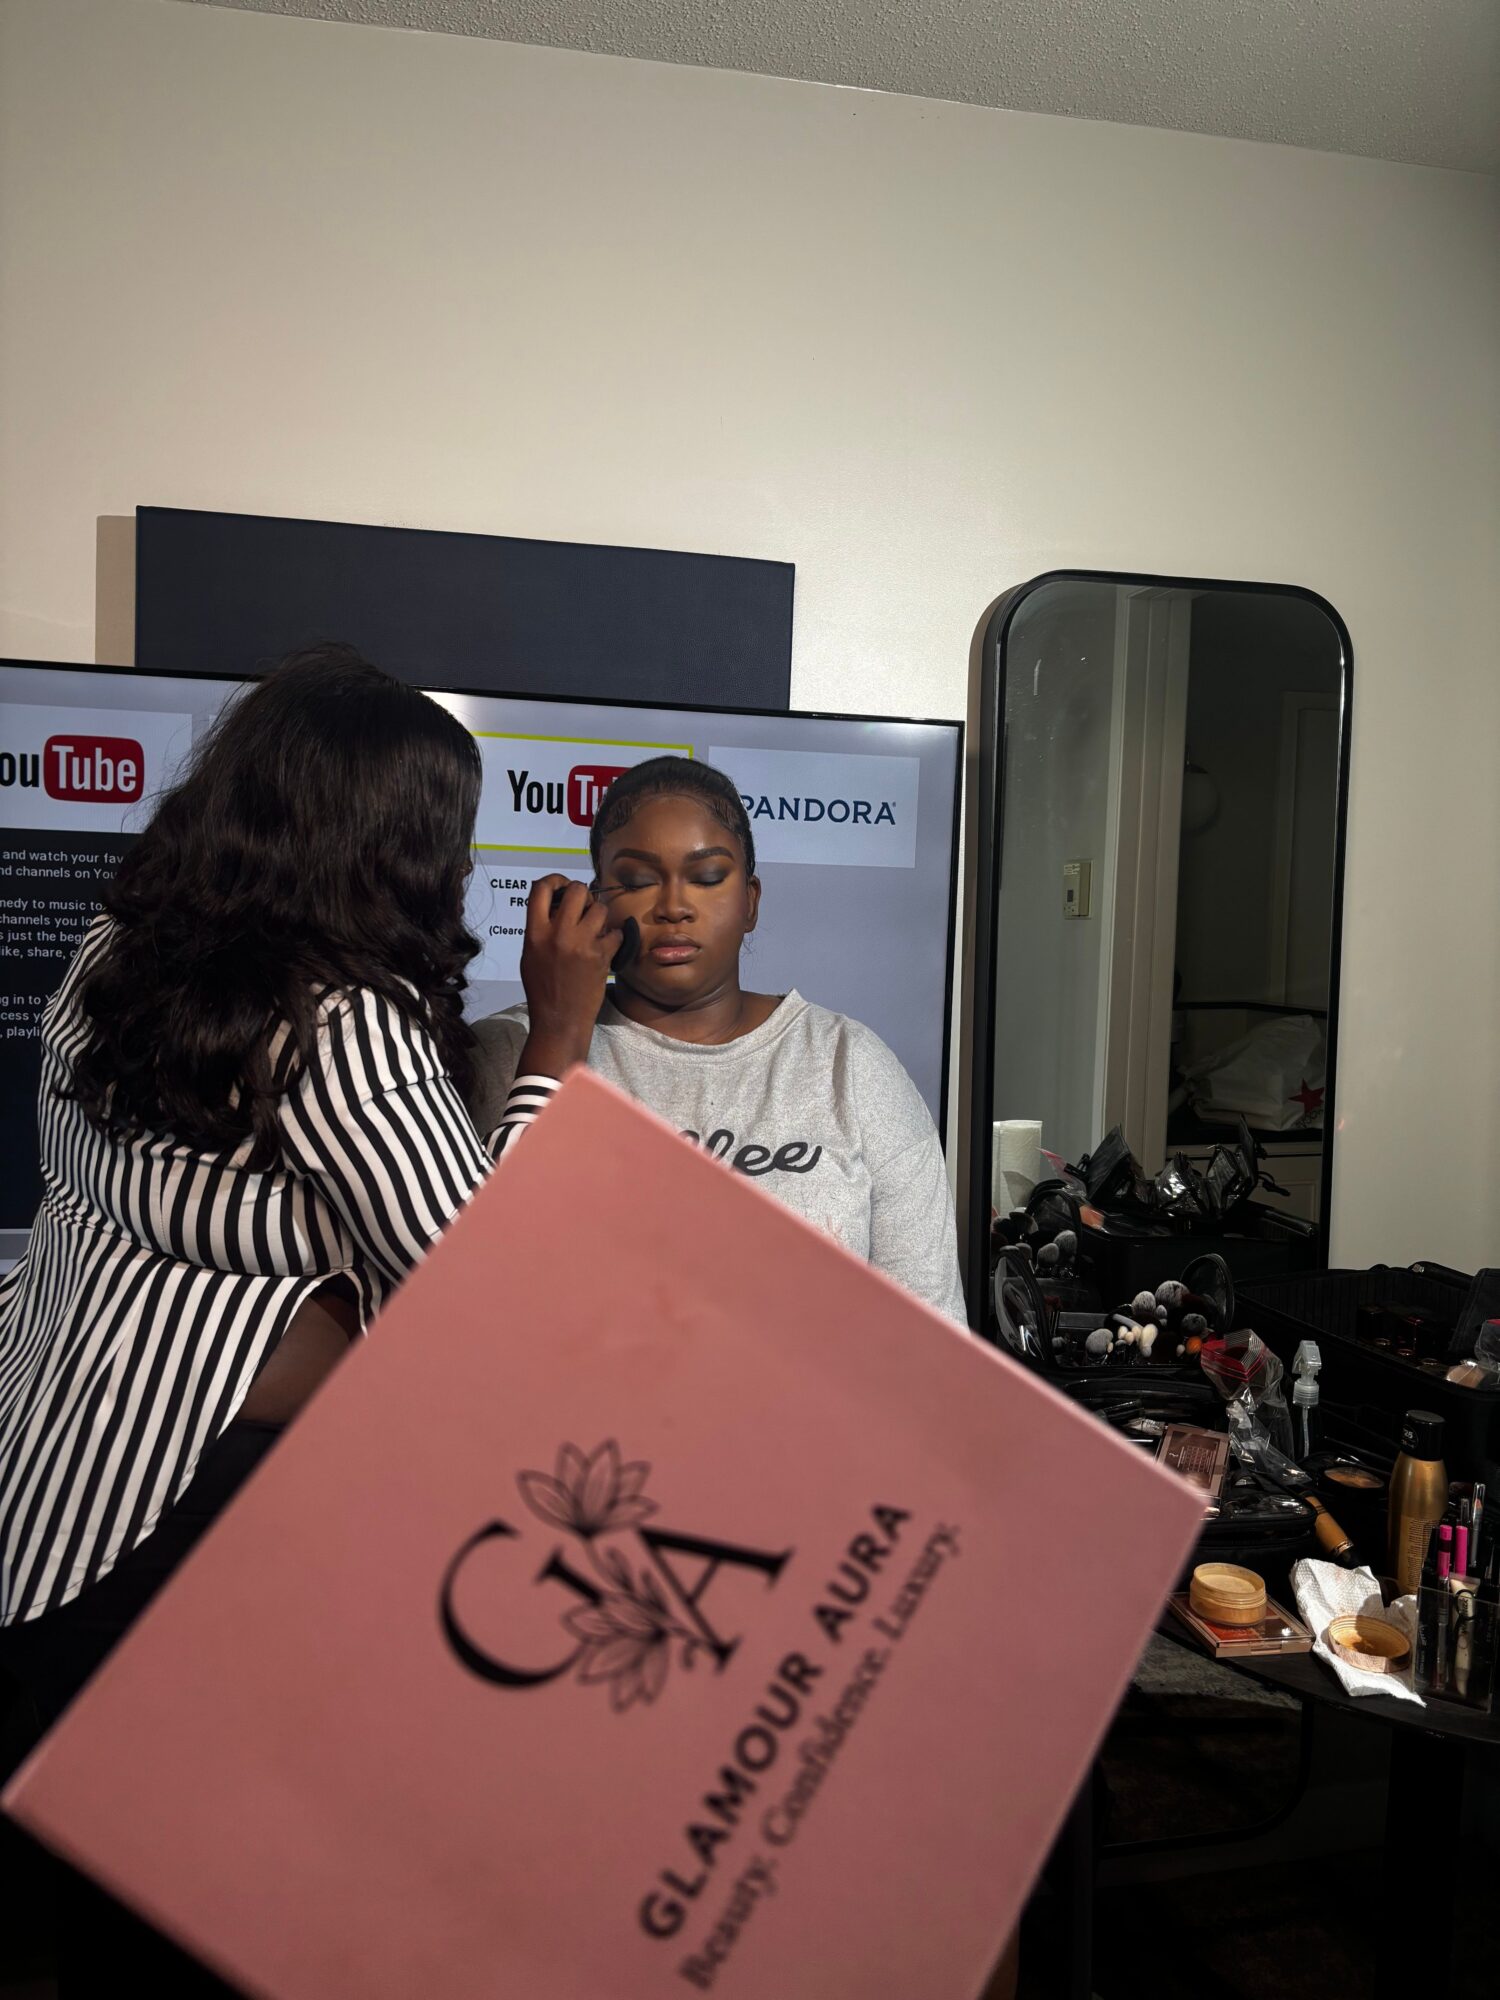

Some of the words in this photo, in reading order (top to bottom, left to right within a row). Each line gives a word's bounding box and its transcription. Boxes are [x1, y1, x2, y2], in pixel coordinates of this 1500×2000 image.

[506, 769, 619, 817] YouTu
[2, 849, 26, 860] and
[28, 851, 68, 862] watch
[70, 853, 100, 865] your
[103, 852, 124, 864] fav
[15, 865, 71, 878] channels
[74, 870, 91, 879] on
[490, 878, 527, 889] CLEAR
[32, 899, 46, 909] to
[49, 900, 87, 911] music
[90, 901, 103, 911] to
[54, 917, 78, 928] you
[7, 930, 32, 943] just
[36, 931, 57, 942] the
[488, 925, 528, 936] (Cleare
[0, 945, 24, 959] ike,
[27, 946, 66, 960] share,
[13, 994, 25, 1005] in
[28, 995, 42, 1005] to
[636, 1649, 826, 1942] GLAMOUR
[810, 1501, 913, 1646] AURA
[676, 1854, 780, 1993] Beauty.
[760, 1644, 892, 1849] Confidence.
[872, 1520, 961, 1642] Luxury.
